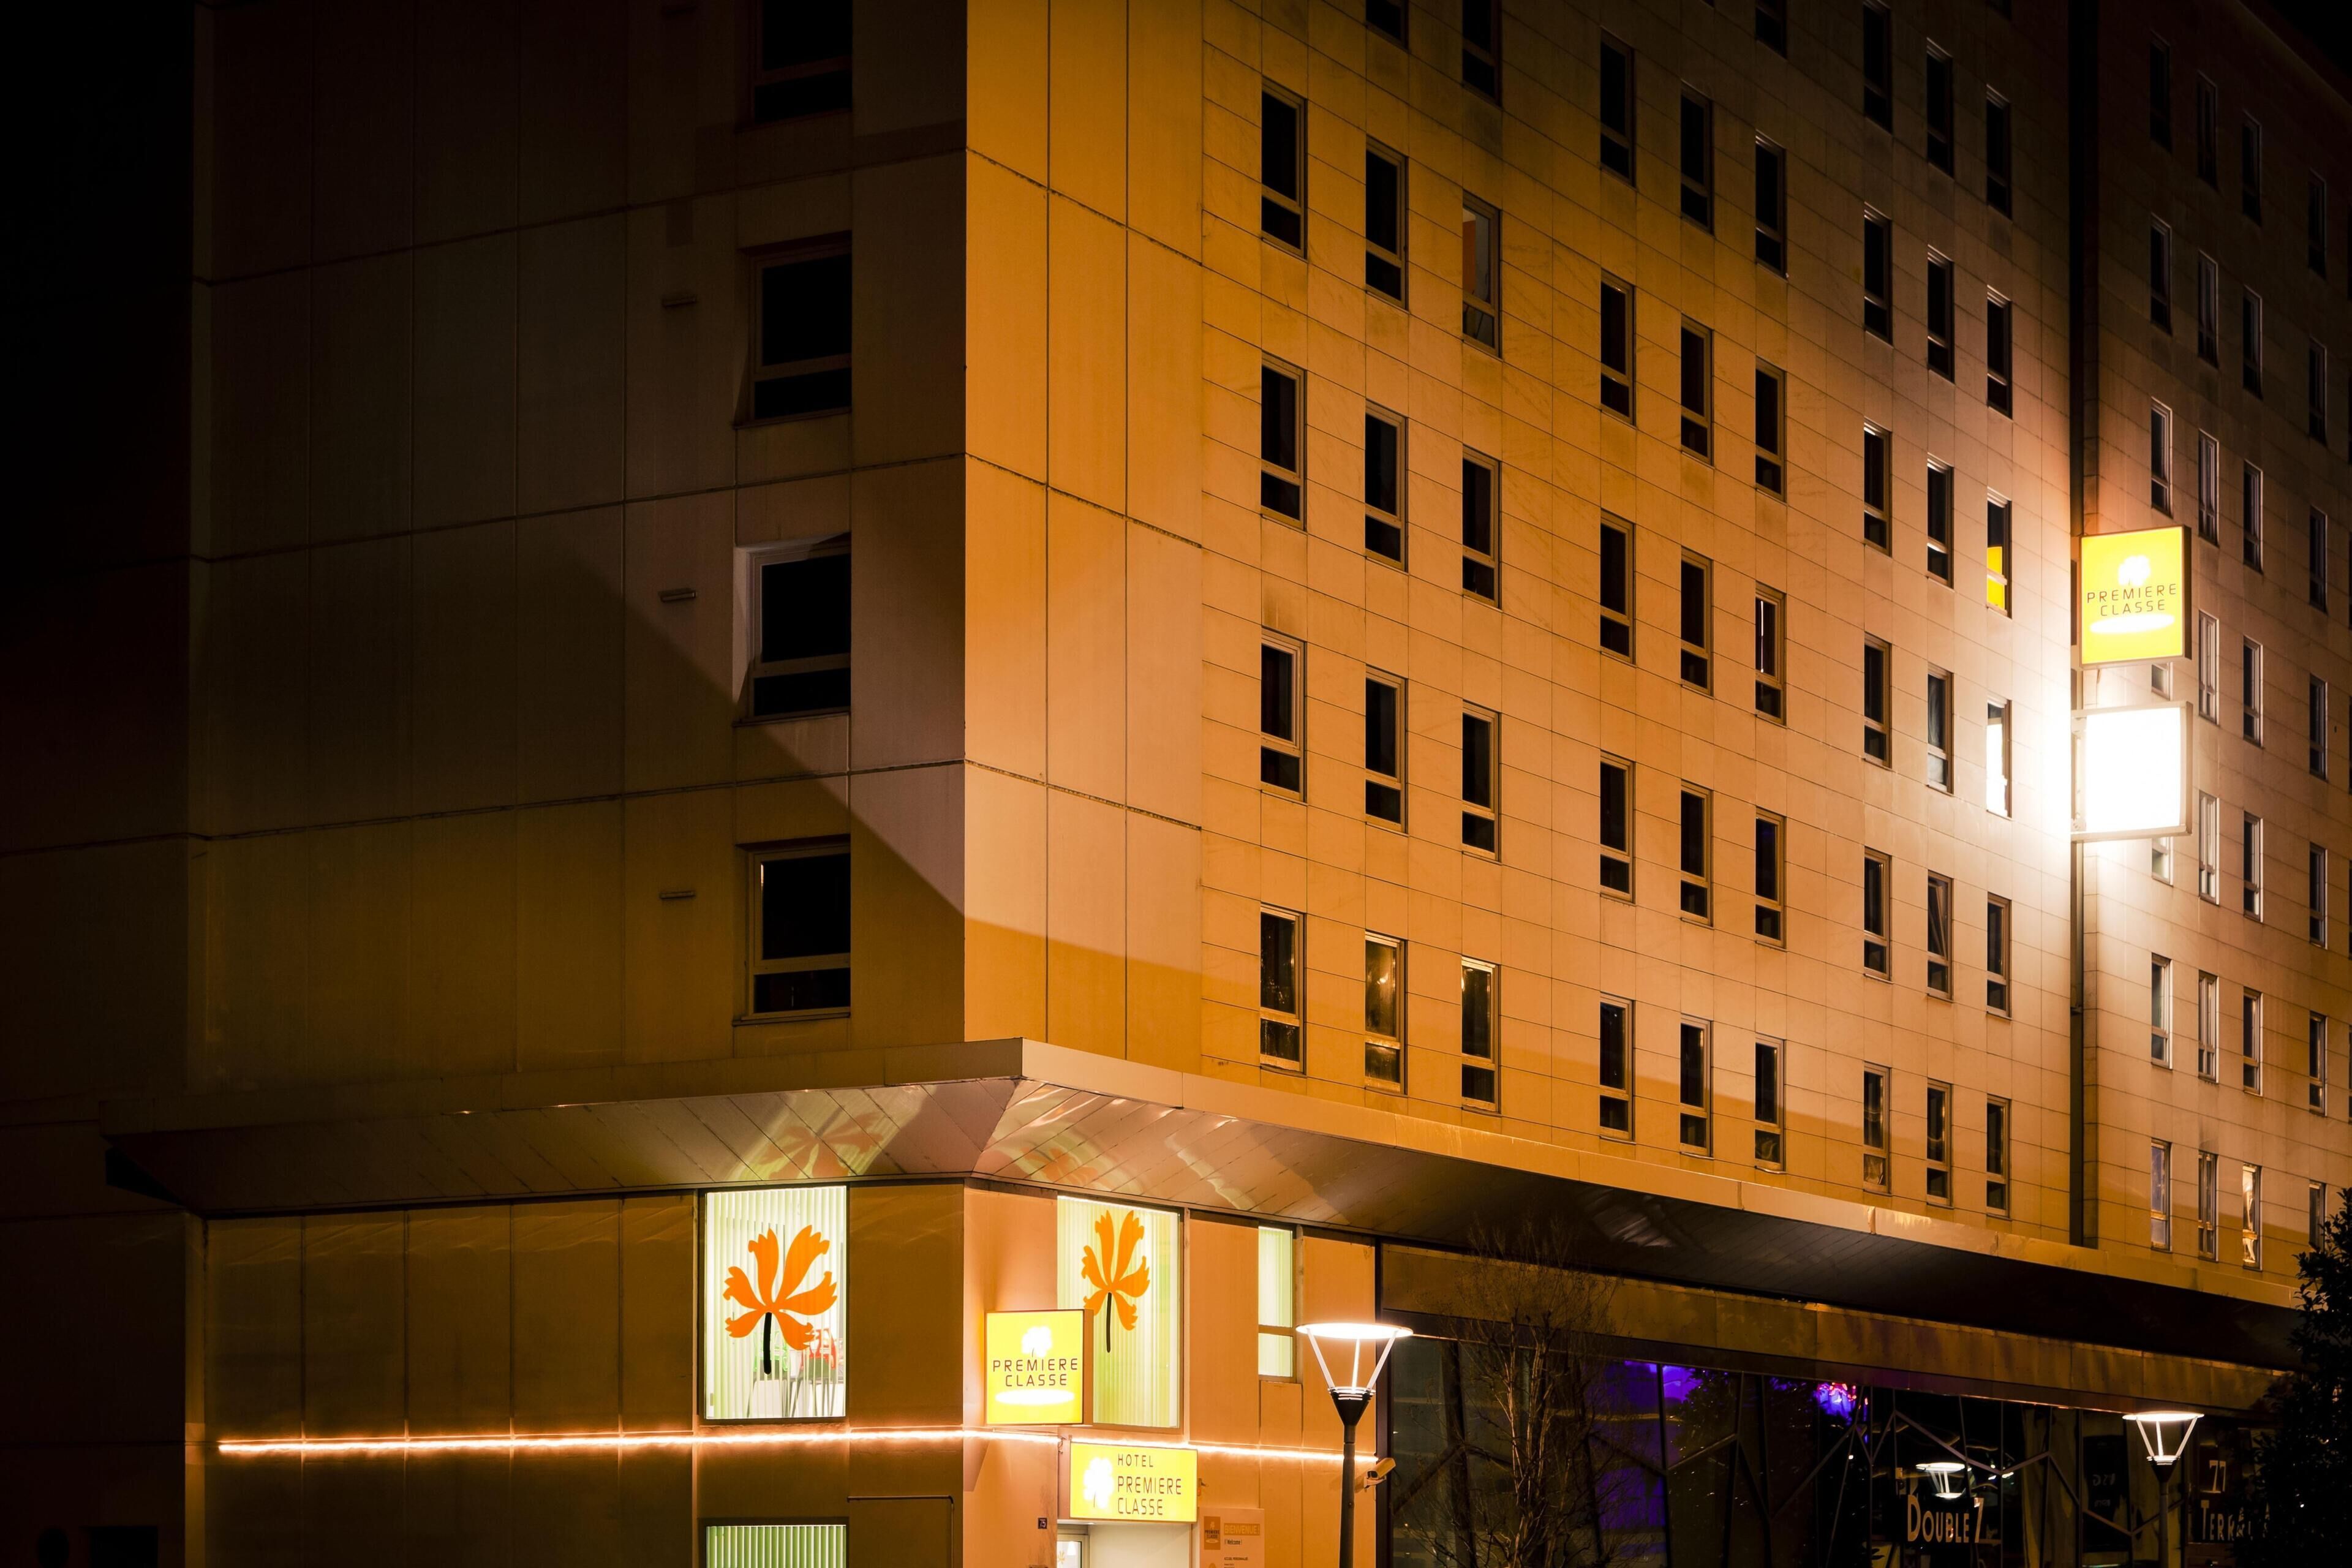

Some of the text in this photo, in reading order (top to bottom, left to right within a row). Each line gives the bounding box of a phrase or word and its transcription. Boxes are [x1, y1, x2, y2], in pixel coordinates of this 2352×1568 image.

[2087, 584, 2176, 603] PREMIERE
[2100, 599, 2166, 616] CLASSE
[993, 1358, 1078, 1373] PREMIERE
[1005, 1373, 1067, 1387] CLASSE
[1117, 1453, 1154, 1468] HOTEL
[1117, 1476, 1182, 1495] PREMIERE
[1117, 1497, 1164, 1516] CLASSE
[1907, 1494, 1985, 1544] DOUBLE 7
